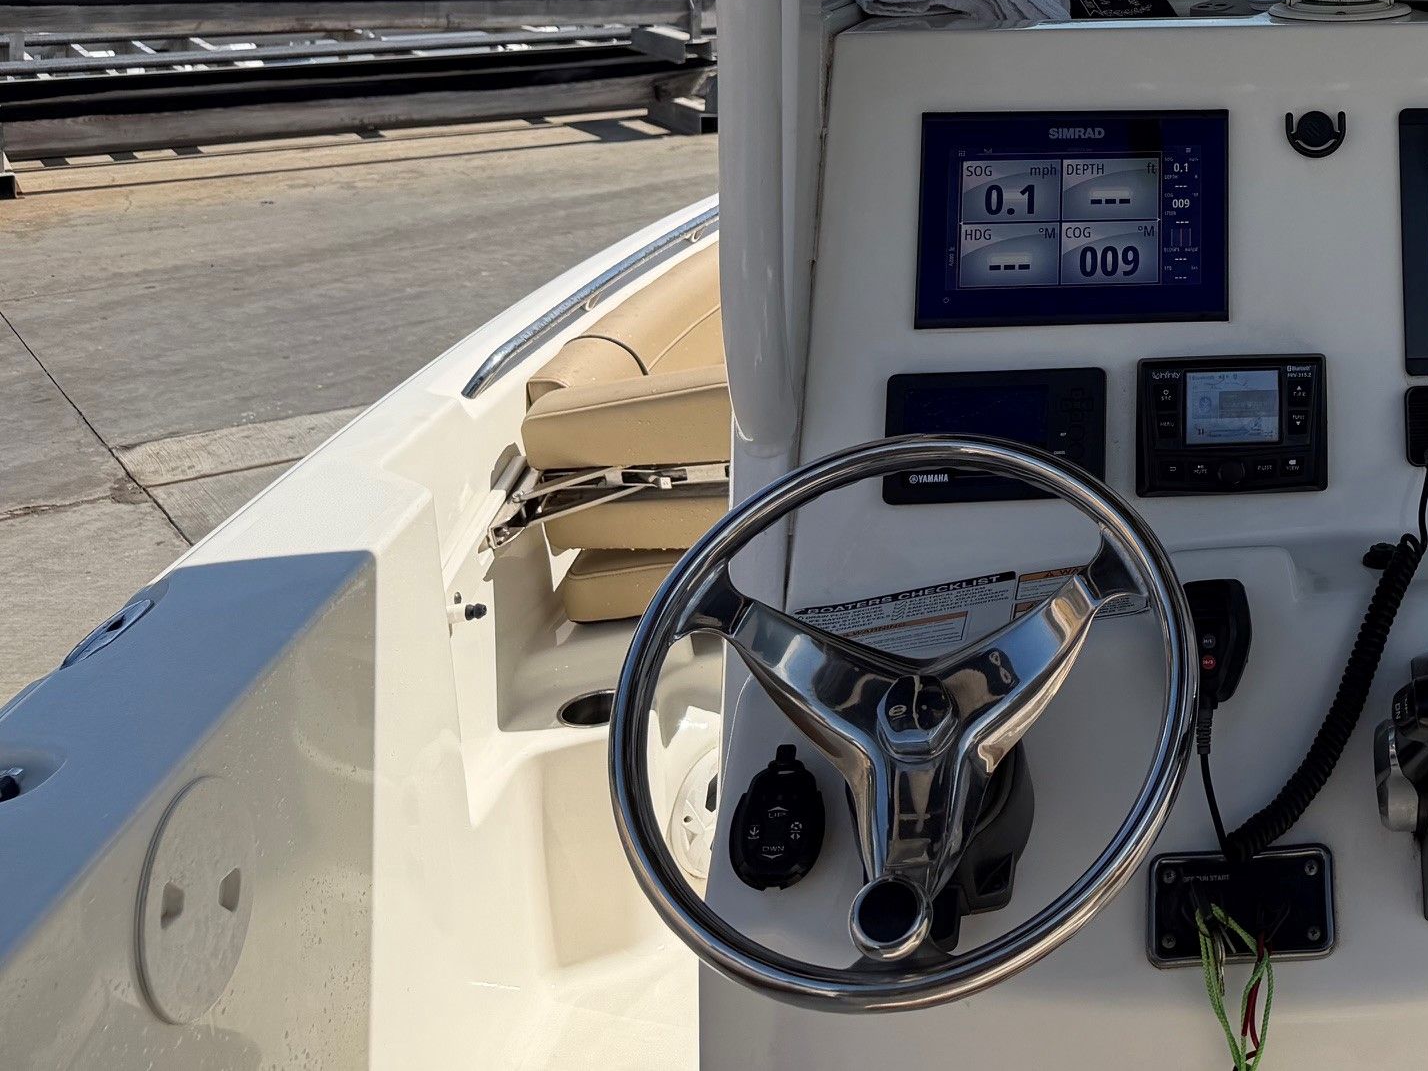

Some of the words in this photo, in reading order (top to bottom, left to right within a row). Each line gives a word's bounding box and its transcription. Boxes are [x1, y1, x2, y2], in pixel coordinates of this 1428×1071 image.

[1048, 128, 1105, 139] SIMRAD
[966, 164, 993, 177] SOG
[1029, 164, 1057, 178] mph
[1066, 163, 1105, 176] DEPTH
[1173, 163, 1189, 172] 0.1
[984, 184, 1036, 216] 0.1
[1172, 199, 1190, 209] 009
[965, 229, 992, 241] HDG
[1065, 227, 1091, 239] COG
[1079, 245, 1140, 278] 009
[918, 473, 949, 483] YAMAHA
[807, 597, 893, 615] BOATERS
[897, 575, 1001, 601] CHECKLIST
